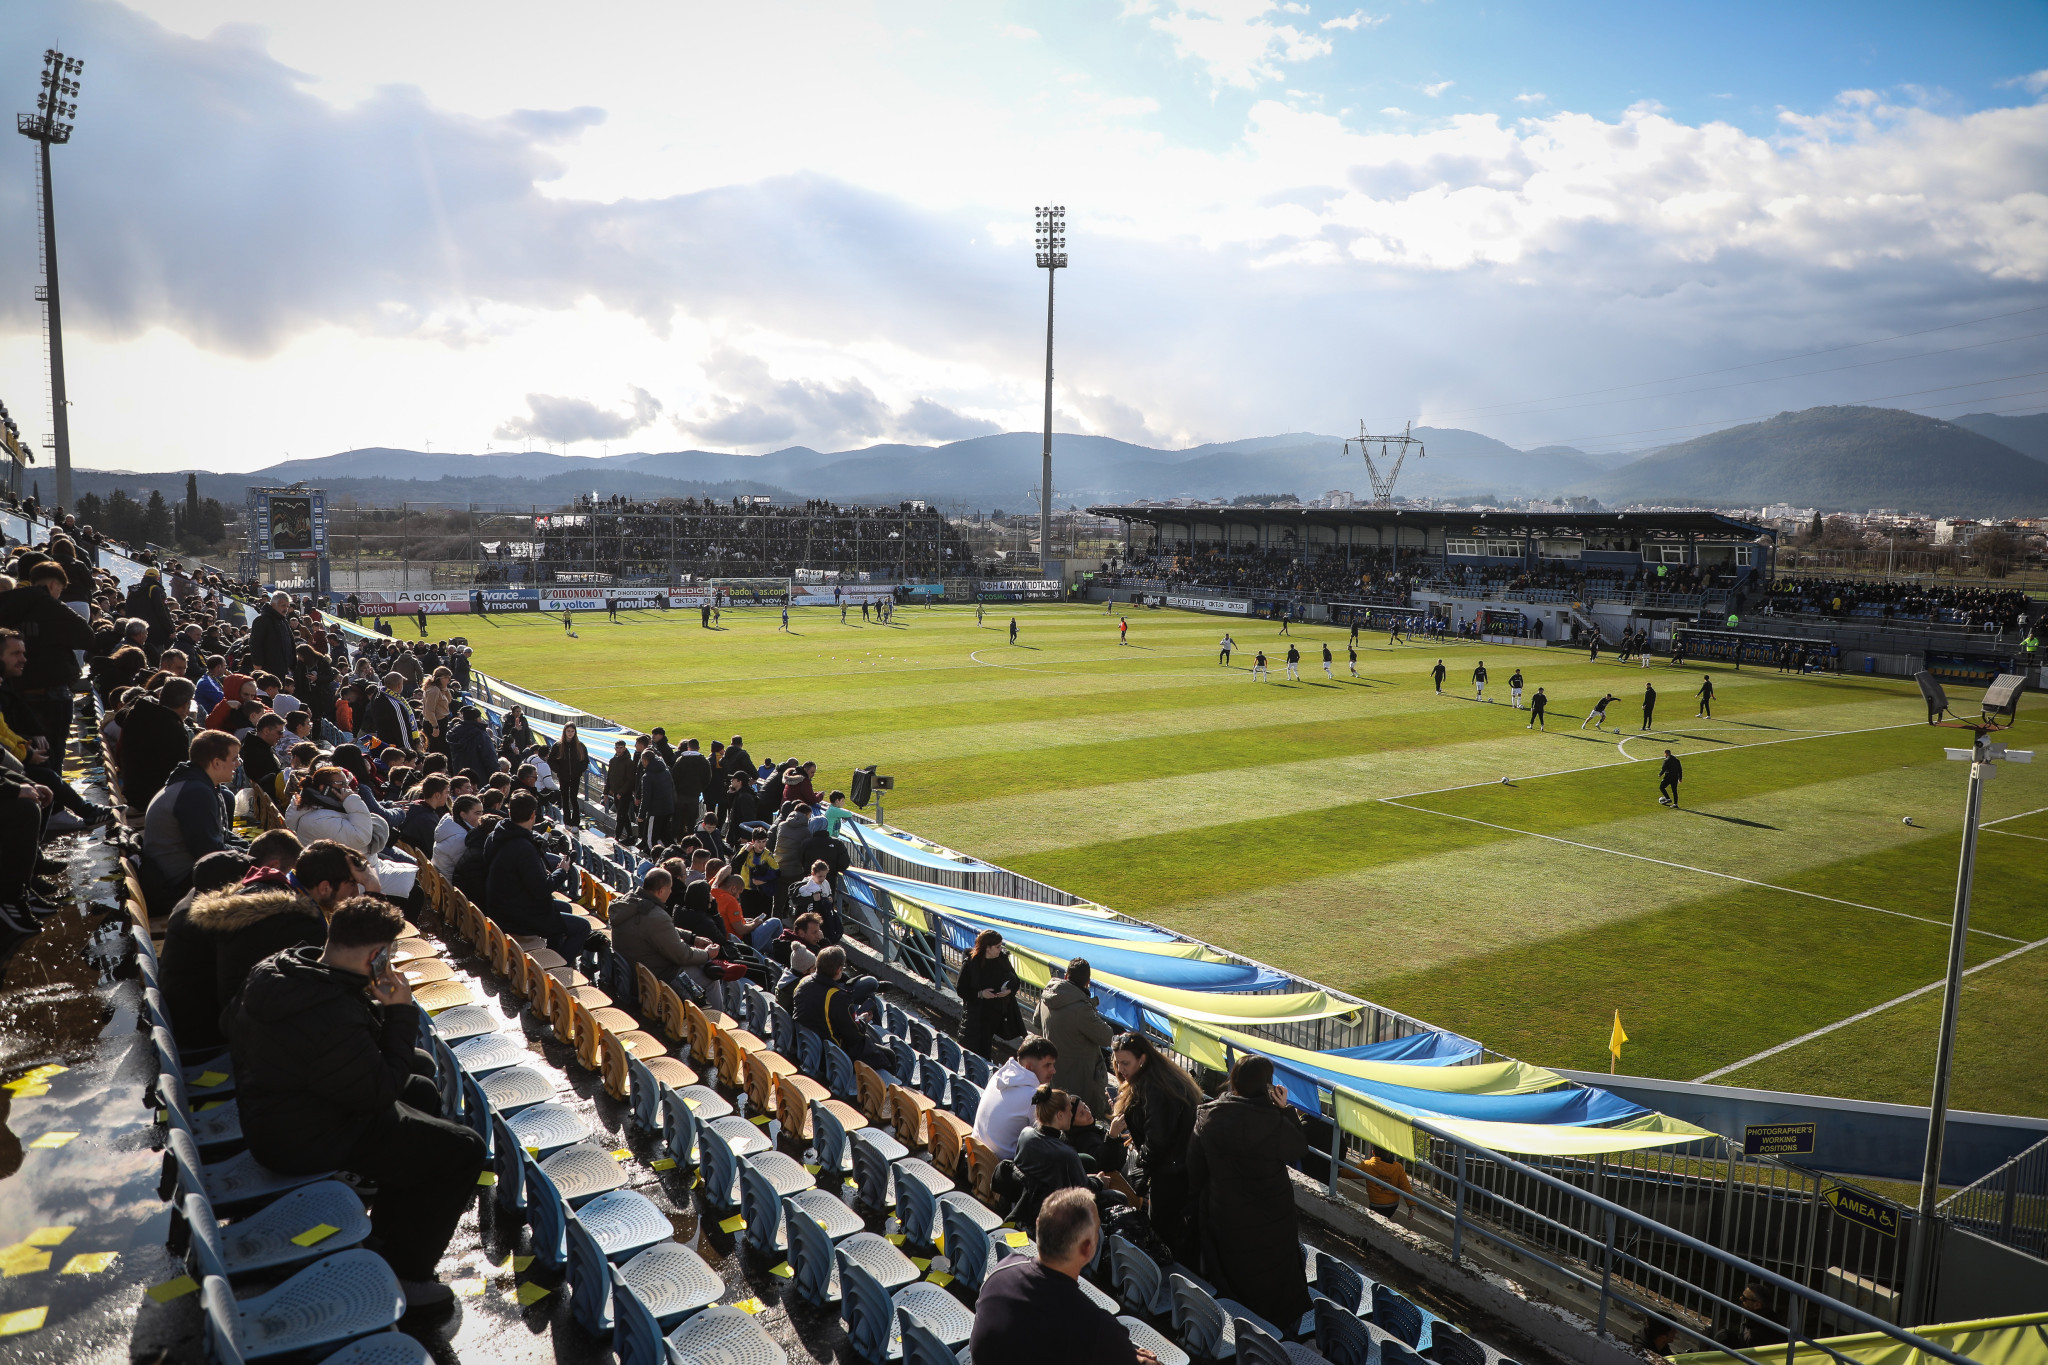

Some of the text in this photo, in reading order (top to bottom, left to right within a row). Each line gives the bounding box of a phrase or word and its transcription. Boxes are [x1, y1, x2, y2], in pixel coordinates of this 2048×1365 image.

[275, 576, 316, 589] novibet
[414, 592, 446, 602] alcon
[491, 602, 528, 610] macron
[562, 601, 596, 610] volton
[1747, 1126, 1813, 1136] PHOTOGRAPHER'S
[1762, 1136, 1797, 1144] WORKING
[1759, 1144, 1798, 1153] POSITIONS
